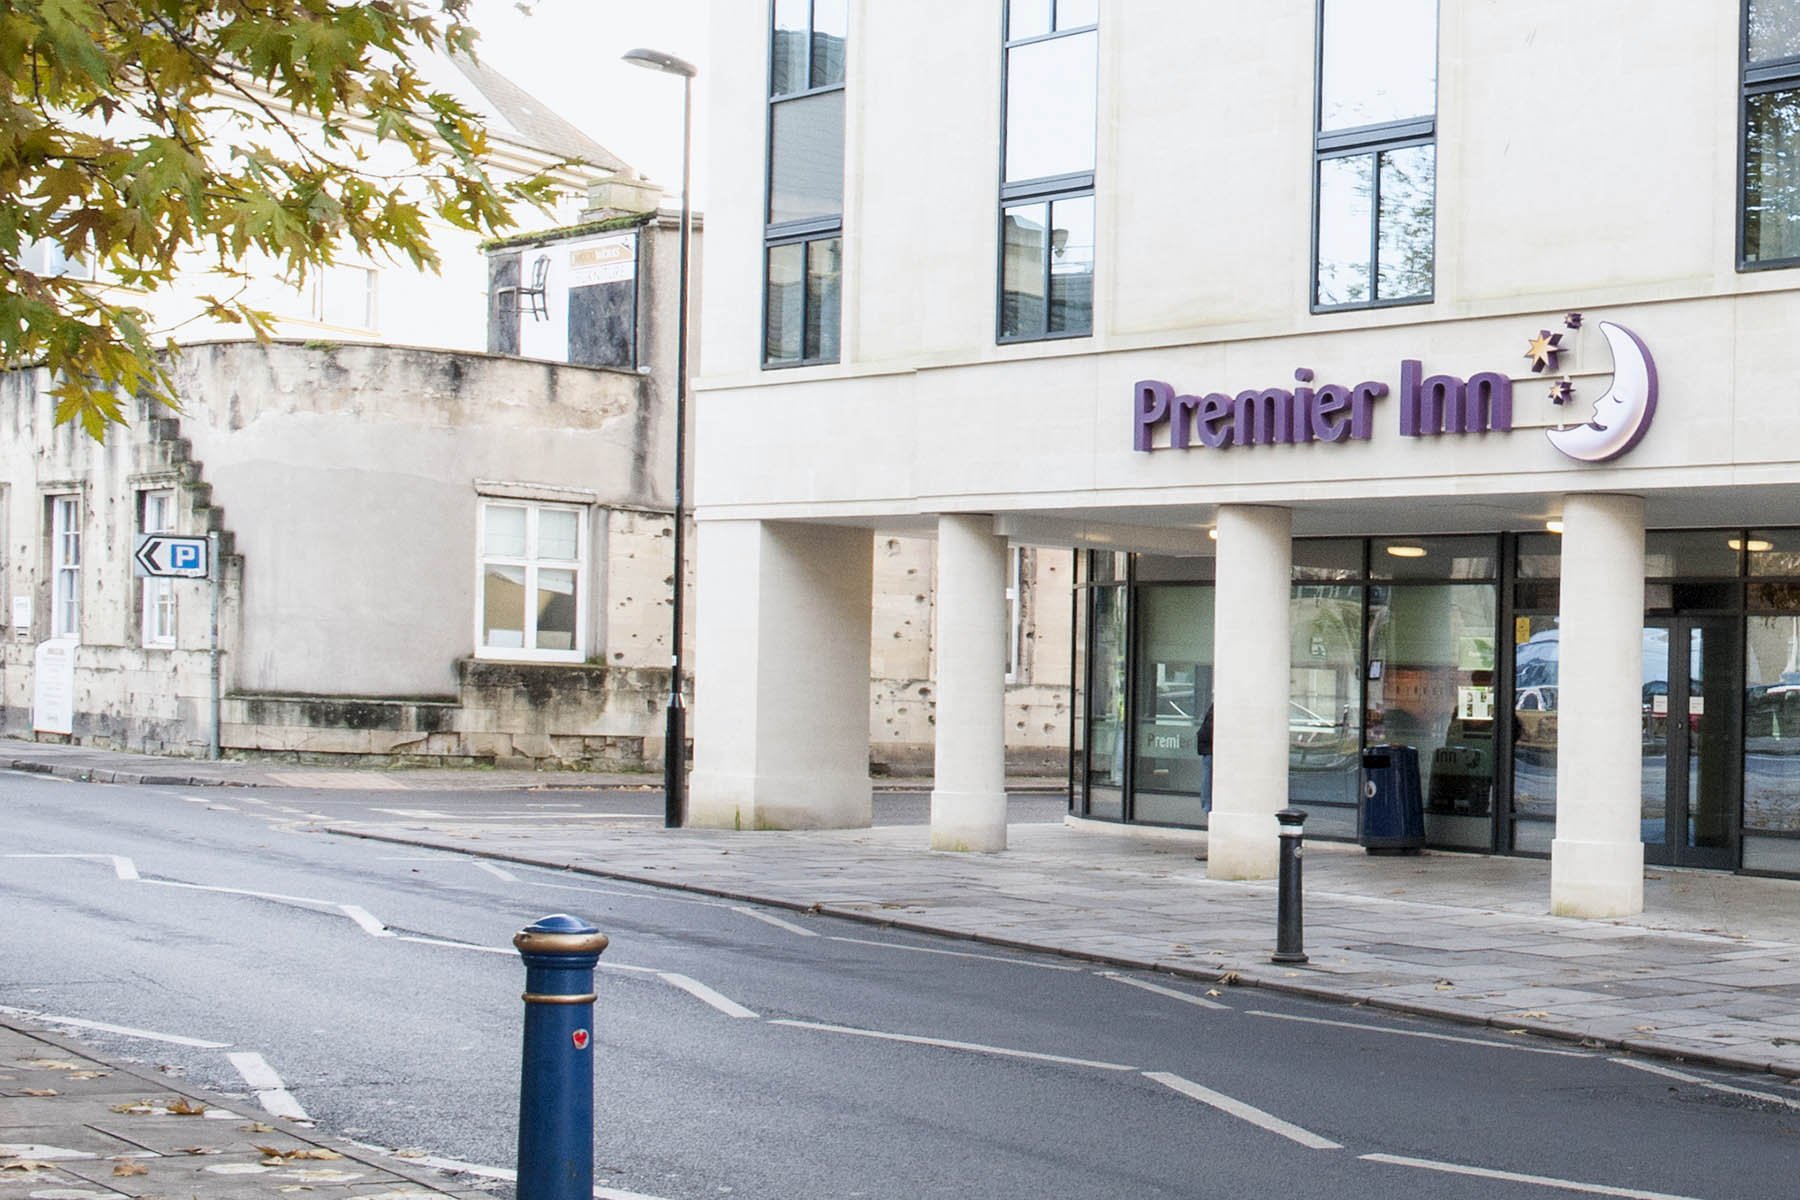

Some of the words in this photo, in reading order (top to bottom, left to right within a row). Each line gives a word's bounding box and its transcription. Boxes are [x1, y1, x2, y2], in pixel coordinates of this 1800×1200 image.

[1134, 367, 1388, 453] Premier
[1400, 359, 1513, 437] Inn
[176, 546, 195, 567] P
